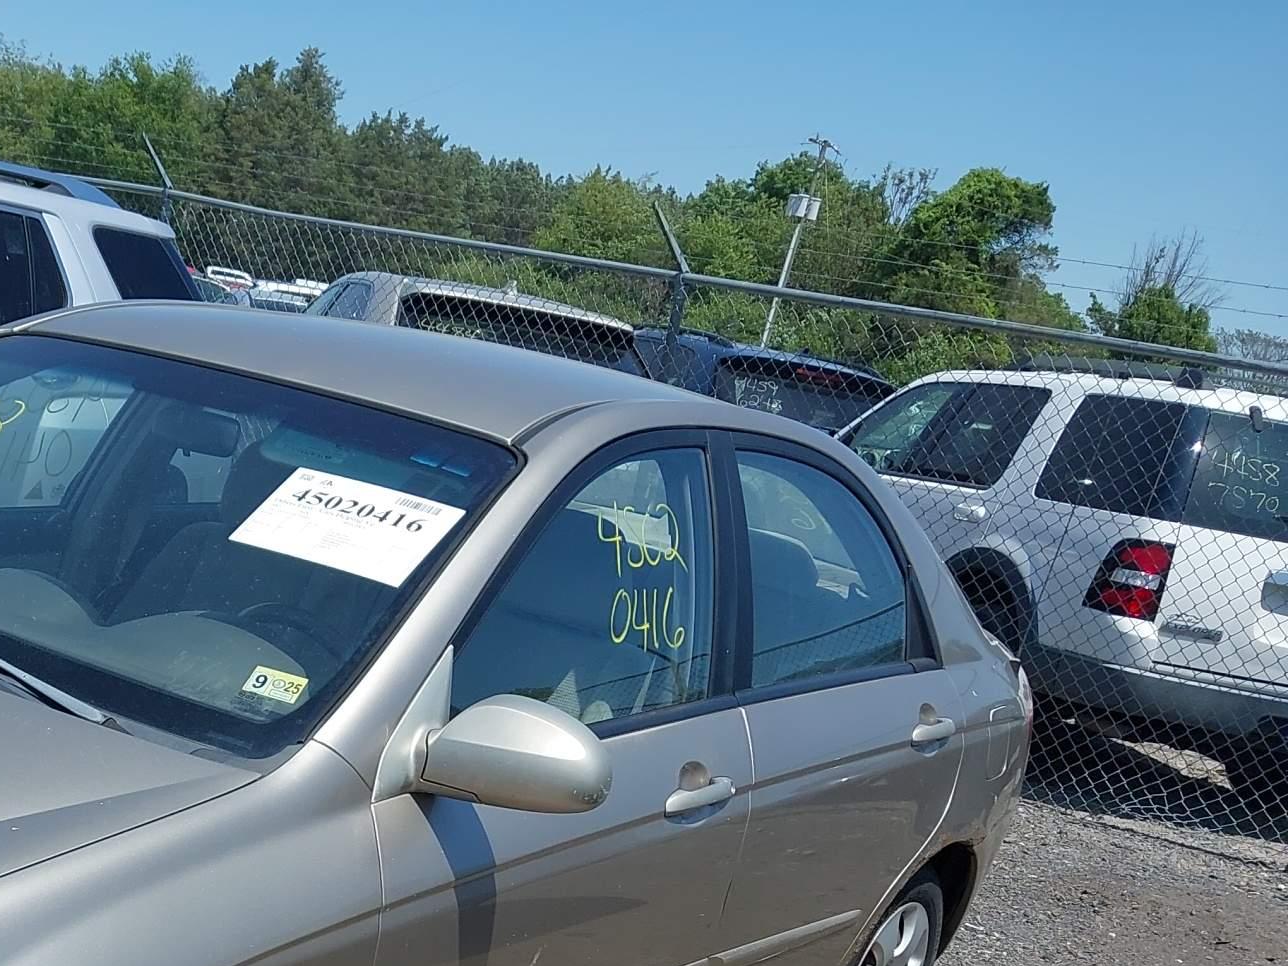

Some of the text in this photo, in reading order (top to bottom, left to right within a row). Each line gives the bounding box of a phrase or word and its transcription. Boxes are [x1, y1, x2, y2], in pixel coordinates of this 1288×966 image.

[291, 488, 429, 533] 45020416
[597, 500, 689, 578] 4502
[610, 586, 686, 654] 0416
[252, 674, 304, 695] 9 25
